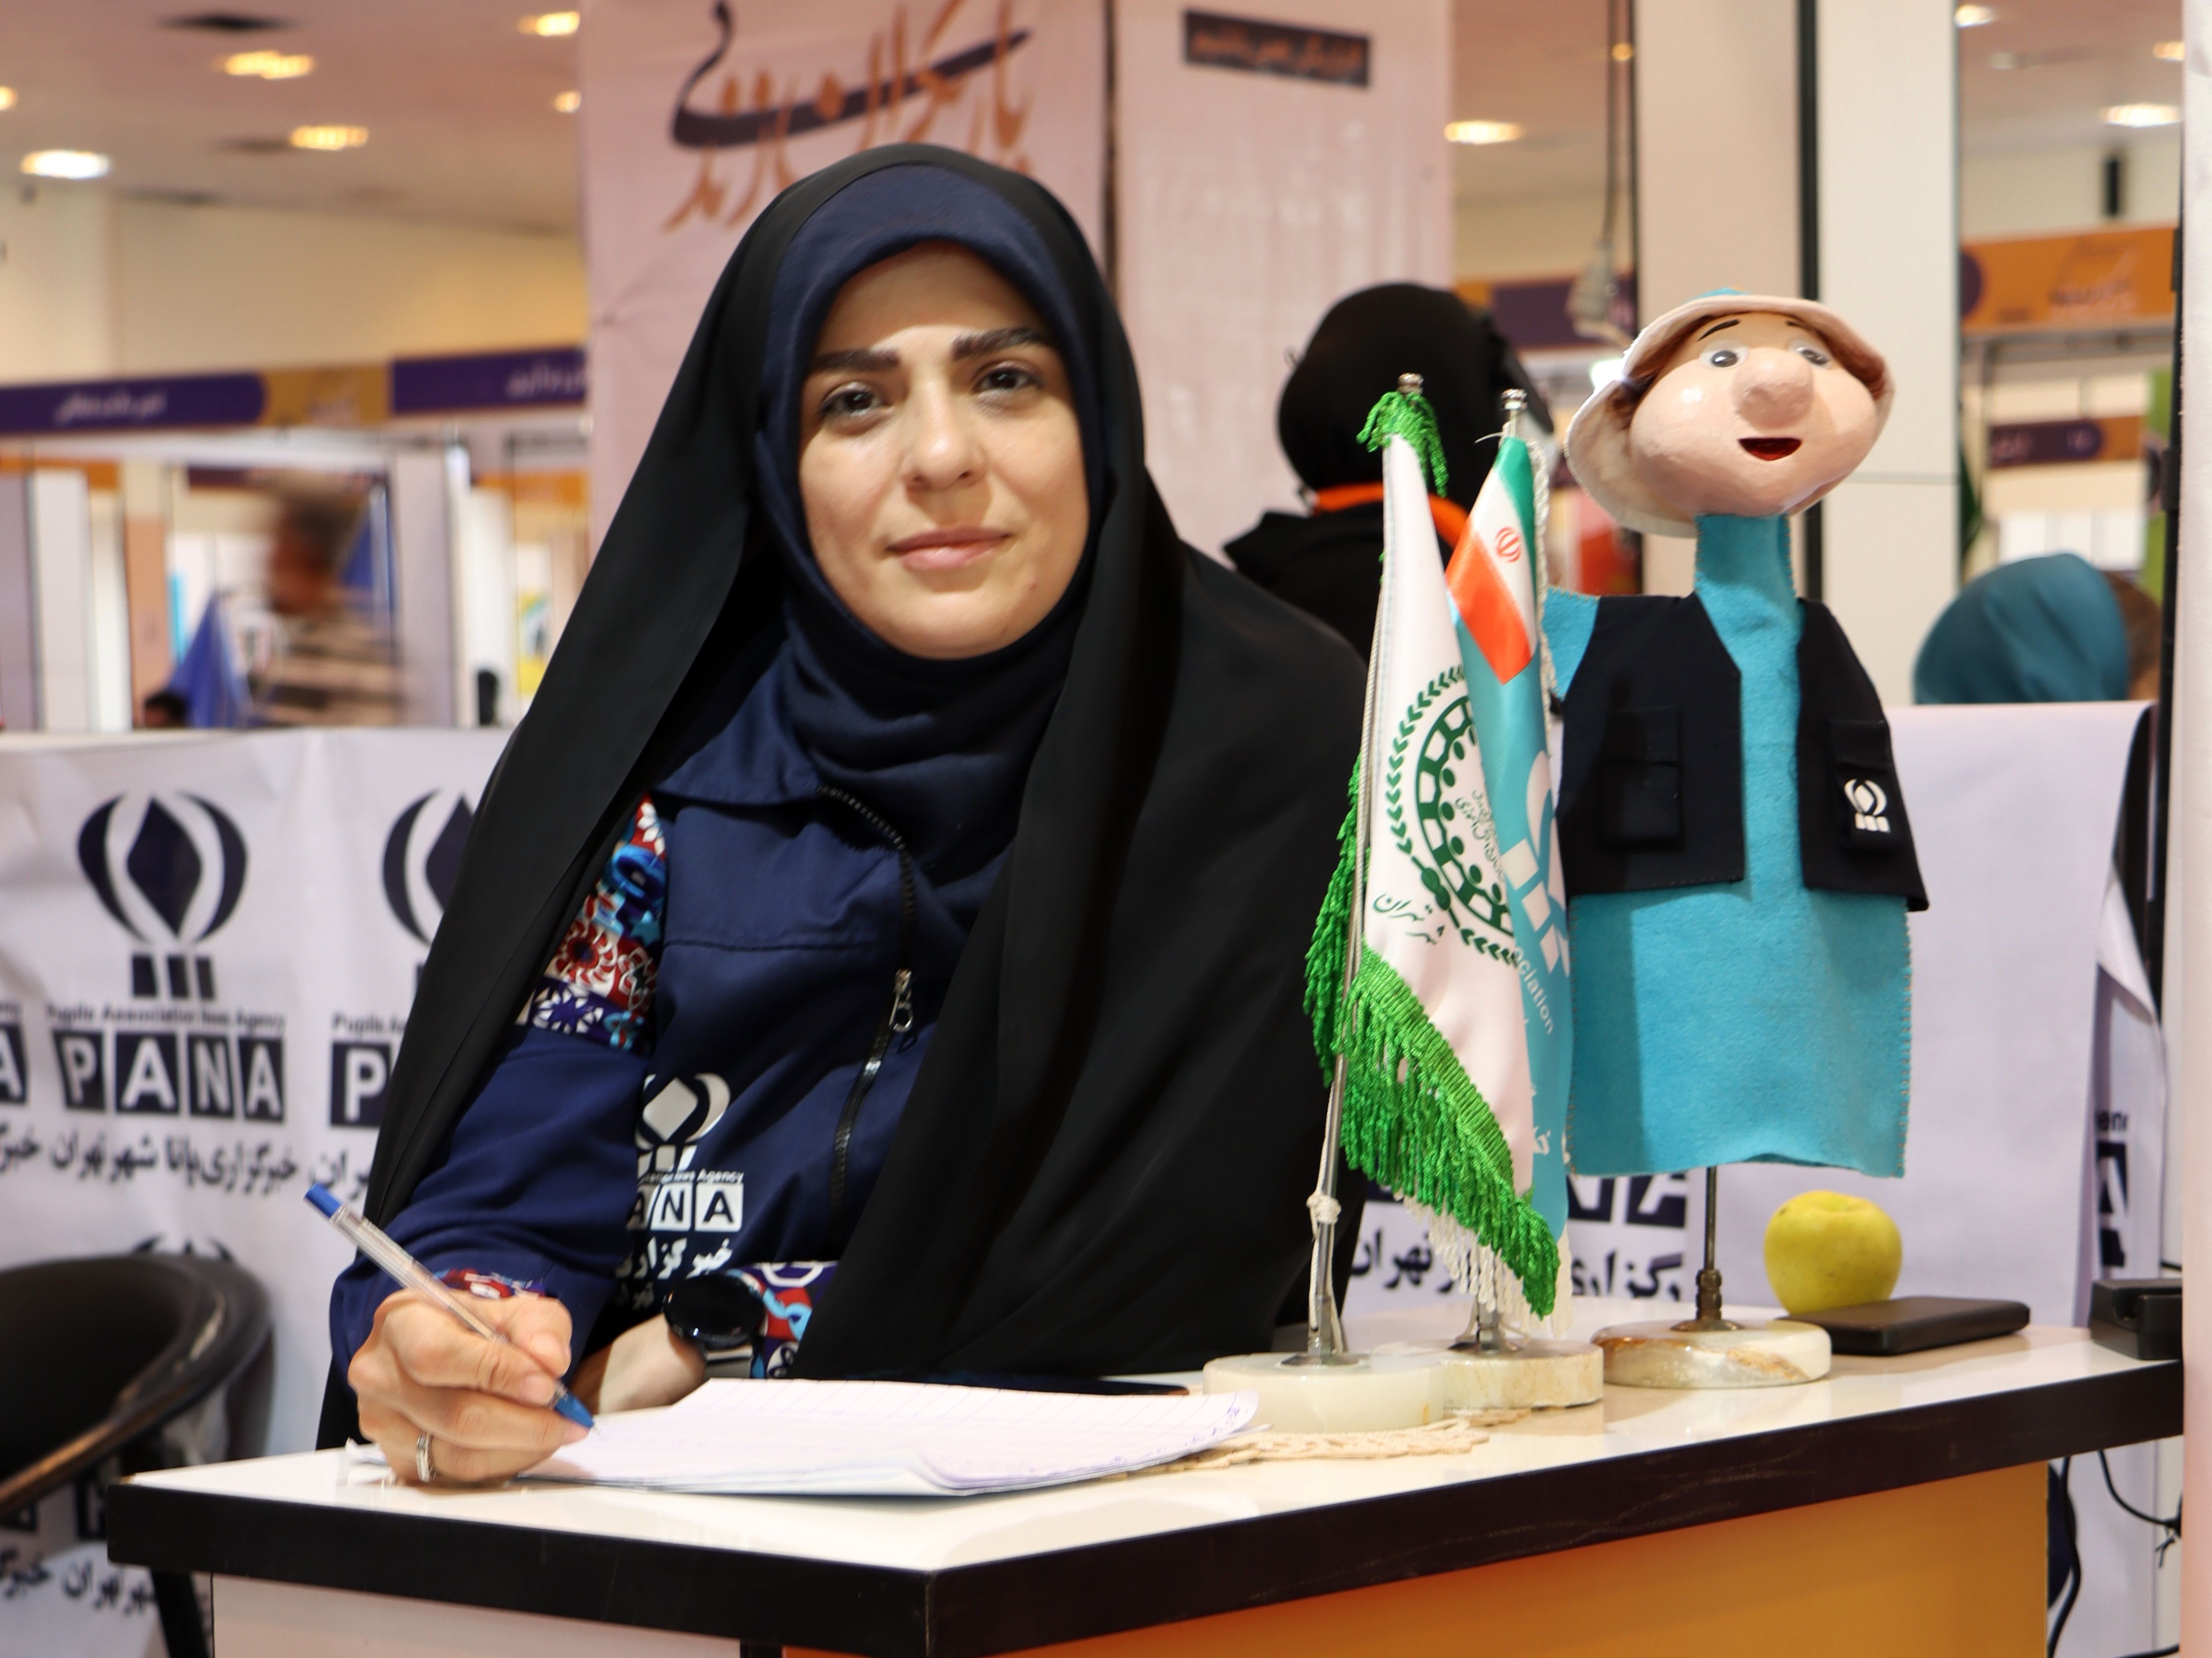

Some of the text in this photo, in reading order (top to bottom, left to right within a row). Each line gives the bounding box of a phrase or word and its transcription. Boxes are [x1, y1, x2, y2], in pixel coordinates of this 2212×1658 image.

[1513, 946, 1554, 1035] ociation
[59, 1034, 285, 1119] PANA
[626, 1187, 739, 1227] ANA
